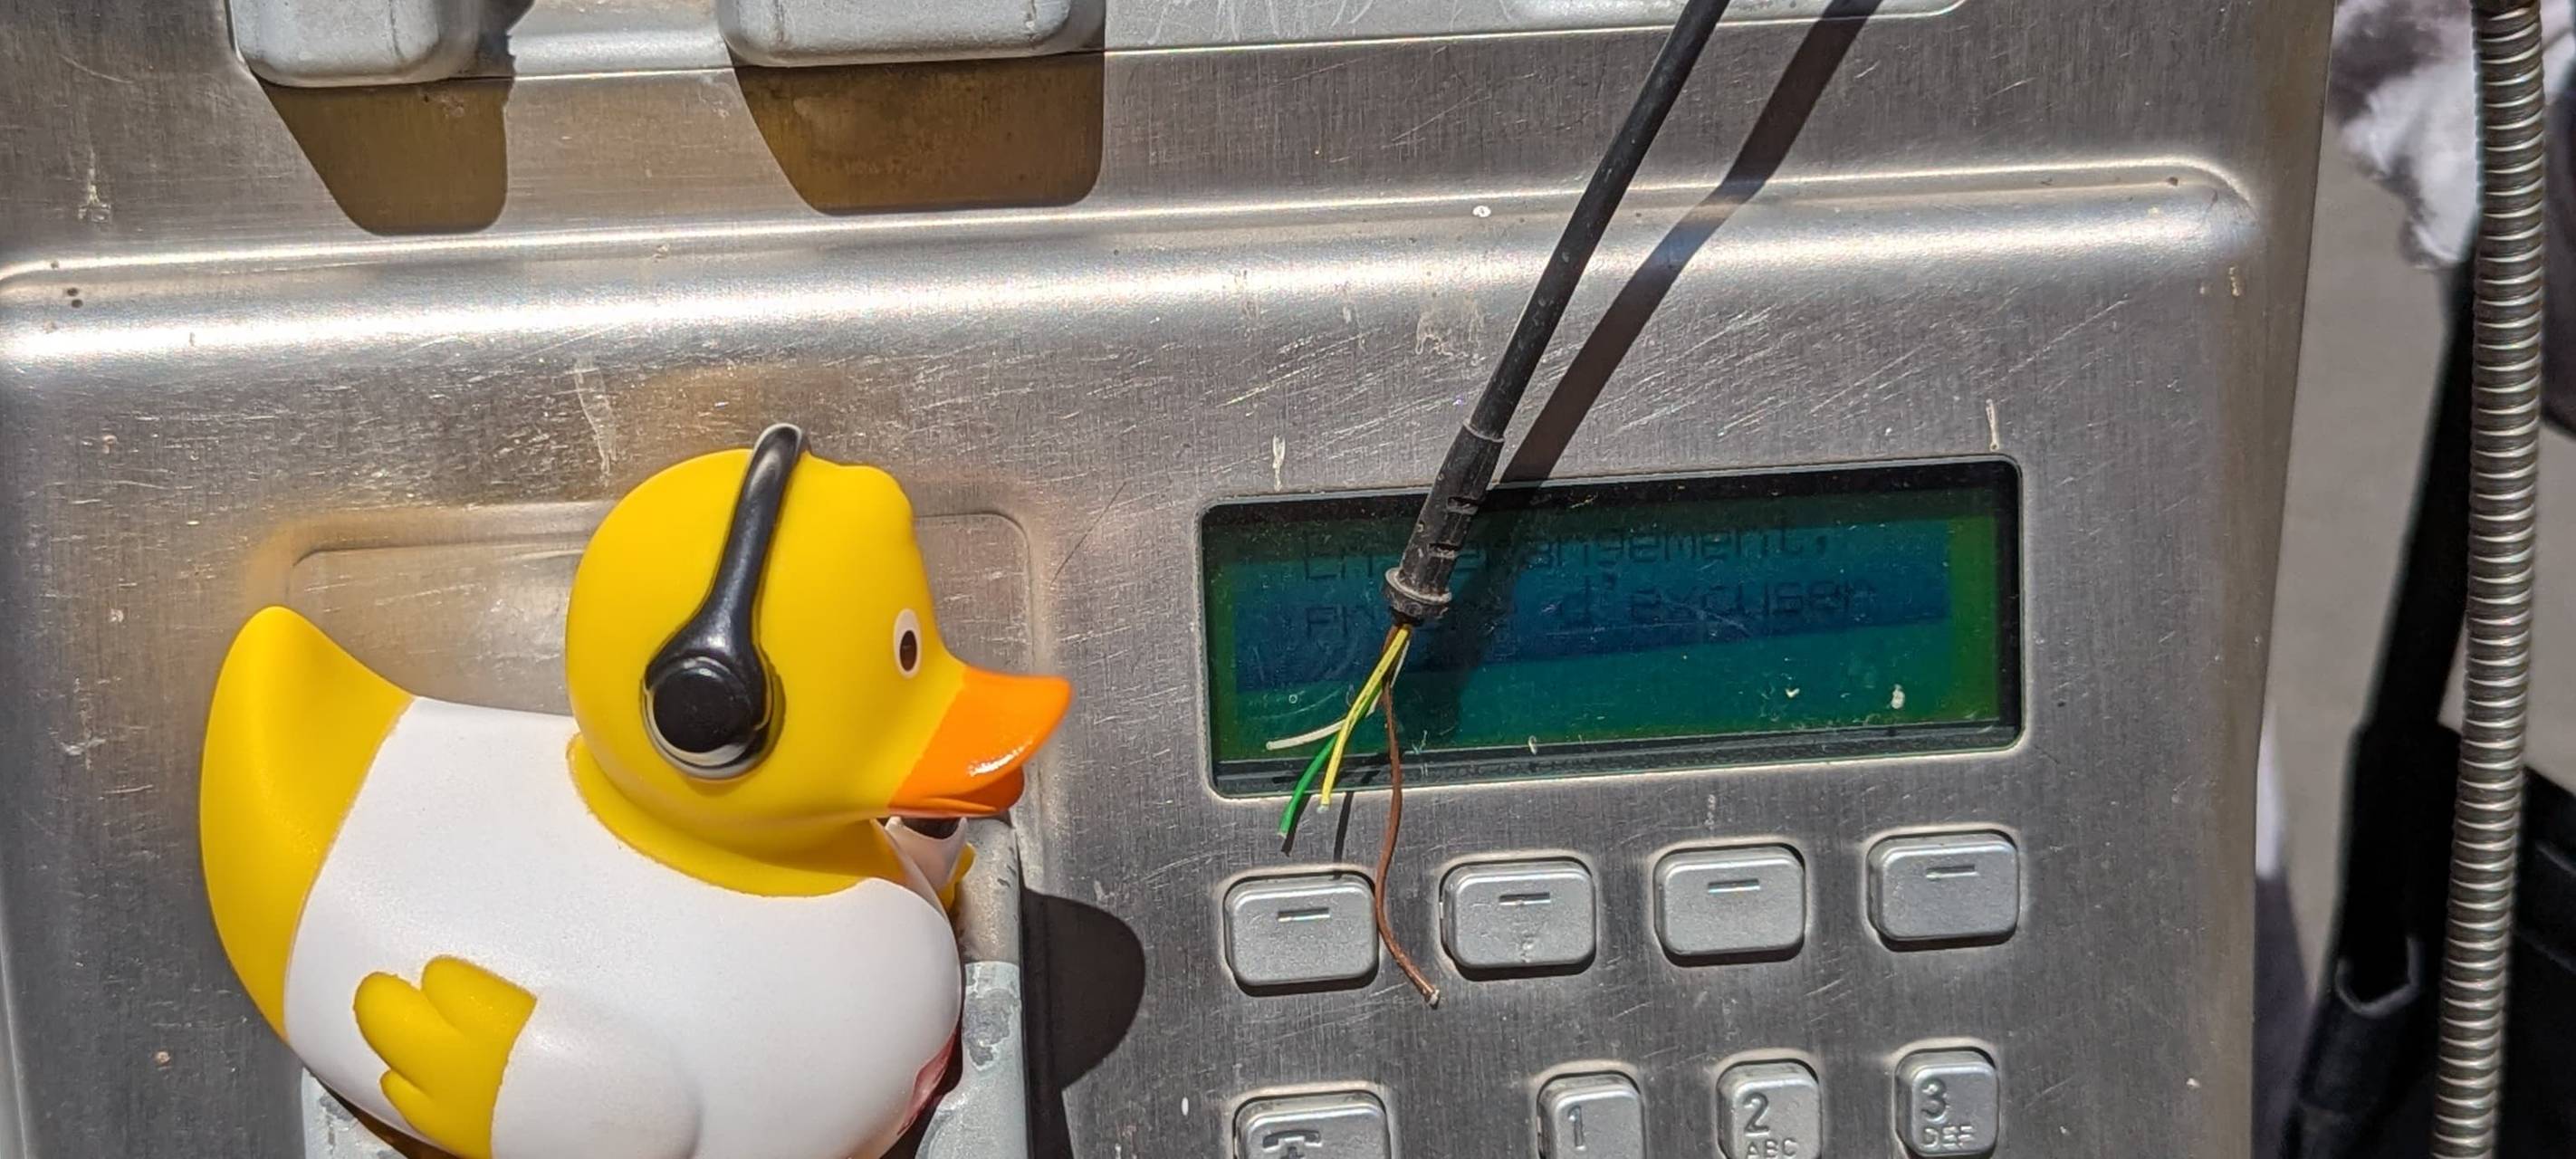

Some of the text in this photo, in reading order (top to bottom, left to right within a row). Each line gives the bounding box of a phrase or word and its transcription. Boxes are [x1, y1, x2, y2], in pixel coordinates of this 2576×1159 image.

[1742, 1091, 1770, 1136] 2
[1920, 1077, 1948, 1123] 3
[1566, 1104, 1585, 1151] 1
[1745, 1136, 1798, 1159] ABC
[1920, 1124, 1977, 1151] DEF
